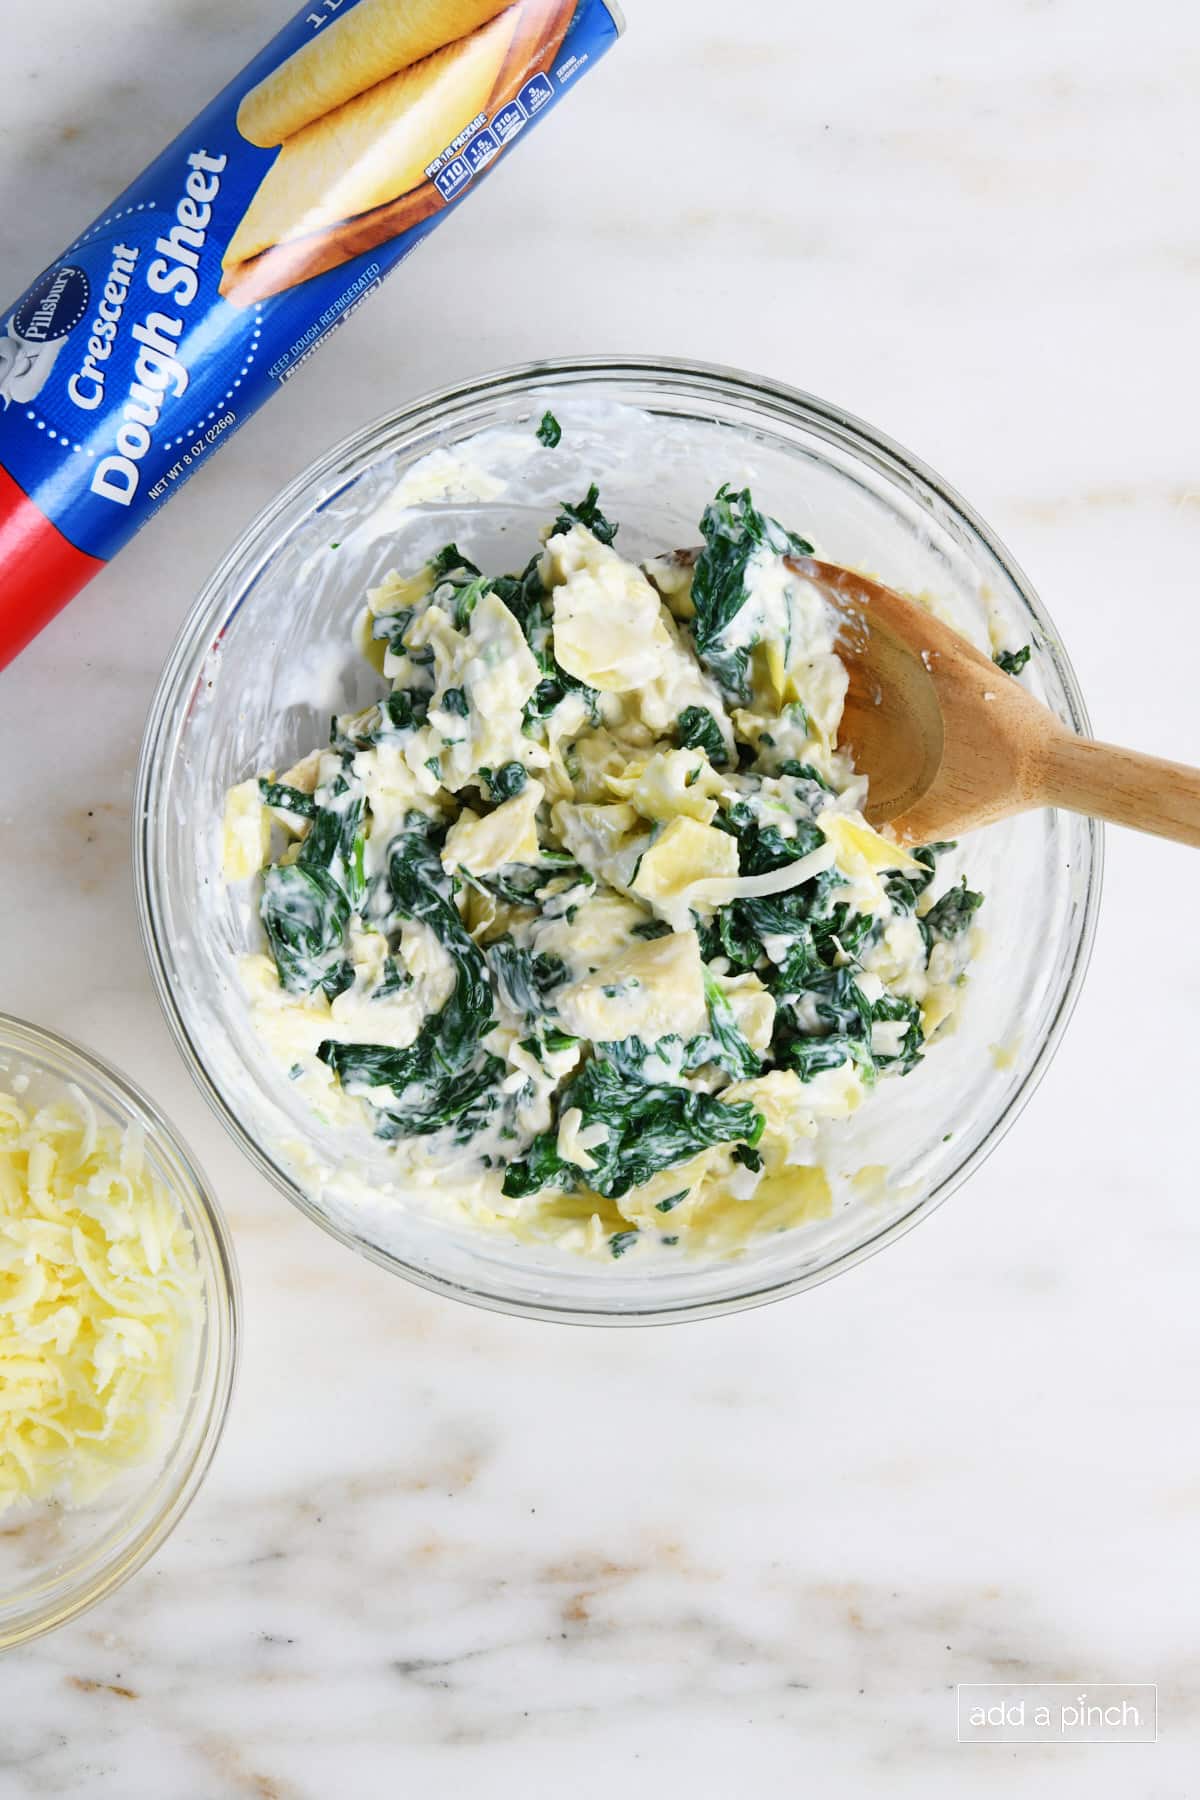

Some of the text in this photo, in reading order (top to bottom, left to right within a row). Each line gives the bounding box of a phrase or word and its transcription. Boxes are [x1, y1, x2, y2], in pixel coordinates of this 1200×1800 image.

[425, 156, 443, 178] PER
[452, 112, 487, 150] PACKAGE
[440, 161, 464, 188] 110
[25, 266, 76, 341] Pillsbury
[67, 243, 139, 411] Crescent
[90, 312, 190, 507] Dough
[146, 149, 228, 308] Sheet
[267, 263, 381, 380] KEEP DOUGH REFRIGERATED
[148, 411, 236, 501] NET WT 8 OZ (226g)
